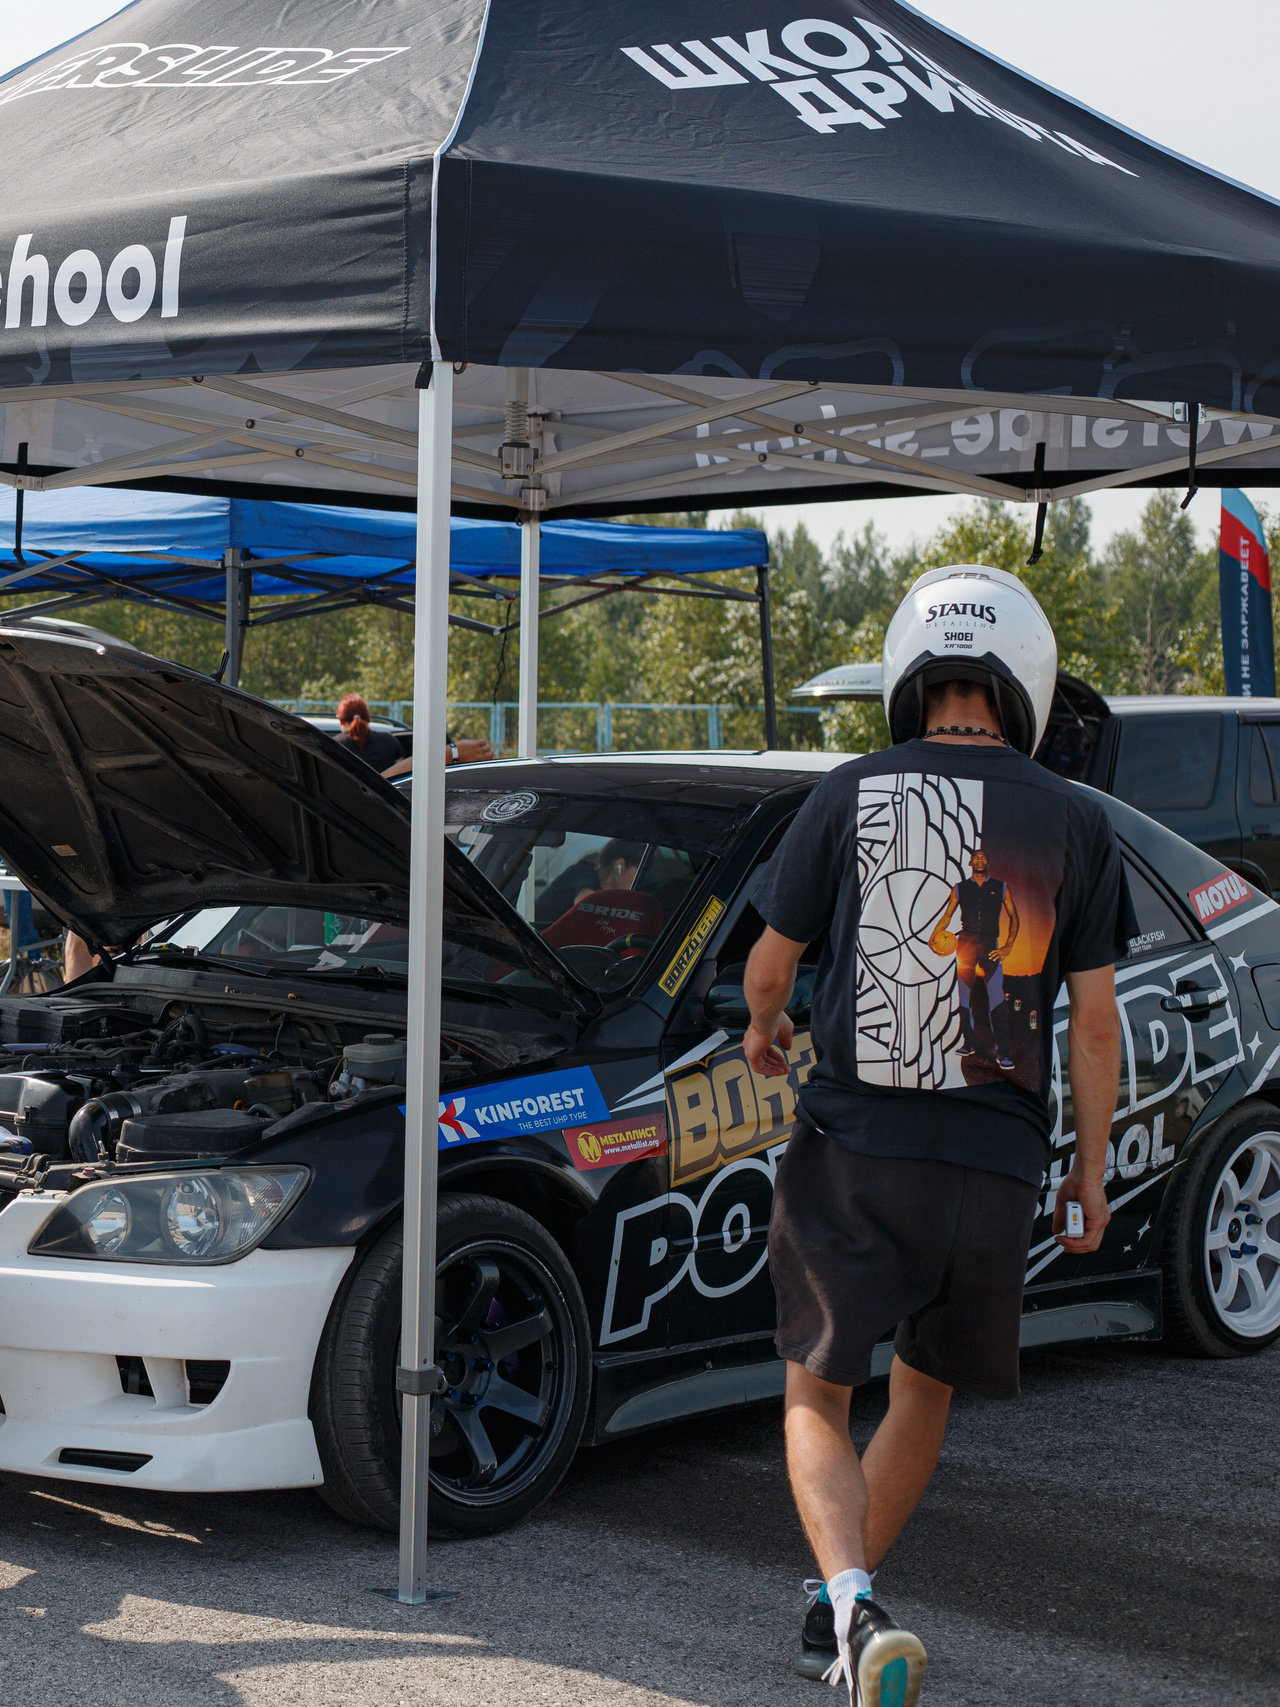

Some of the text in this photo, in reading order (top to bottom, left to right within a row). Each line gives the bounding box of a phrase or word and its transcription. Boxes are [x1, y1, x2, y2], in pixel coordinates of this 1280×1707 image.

[1239, 536, 1250, 650] ЗАРЖАВЕЕТ
[926, 602, 997, 625] STATUS
[926, 620, 995, 631] DETAILING
[944, 632, 973, 642] SHOEI
[1240, 653, 1251, 679] НЕ
[1195, 873, 1248, 920] MOTUL
[577, 902, 644, 921] BRIDE
[1129, 930, 1166, 948] BLACKFISH
[474, 1087, 585, 1126] KINFOREST
[518, 1111, 588, 1131] THE BEST UHP TYRE
[599, 1126, 657, 1147] МЕТАЛЛИСТ
[603, 1139, 660, 1155] www.metallist.org
